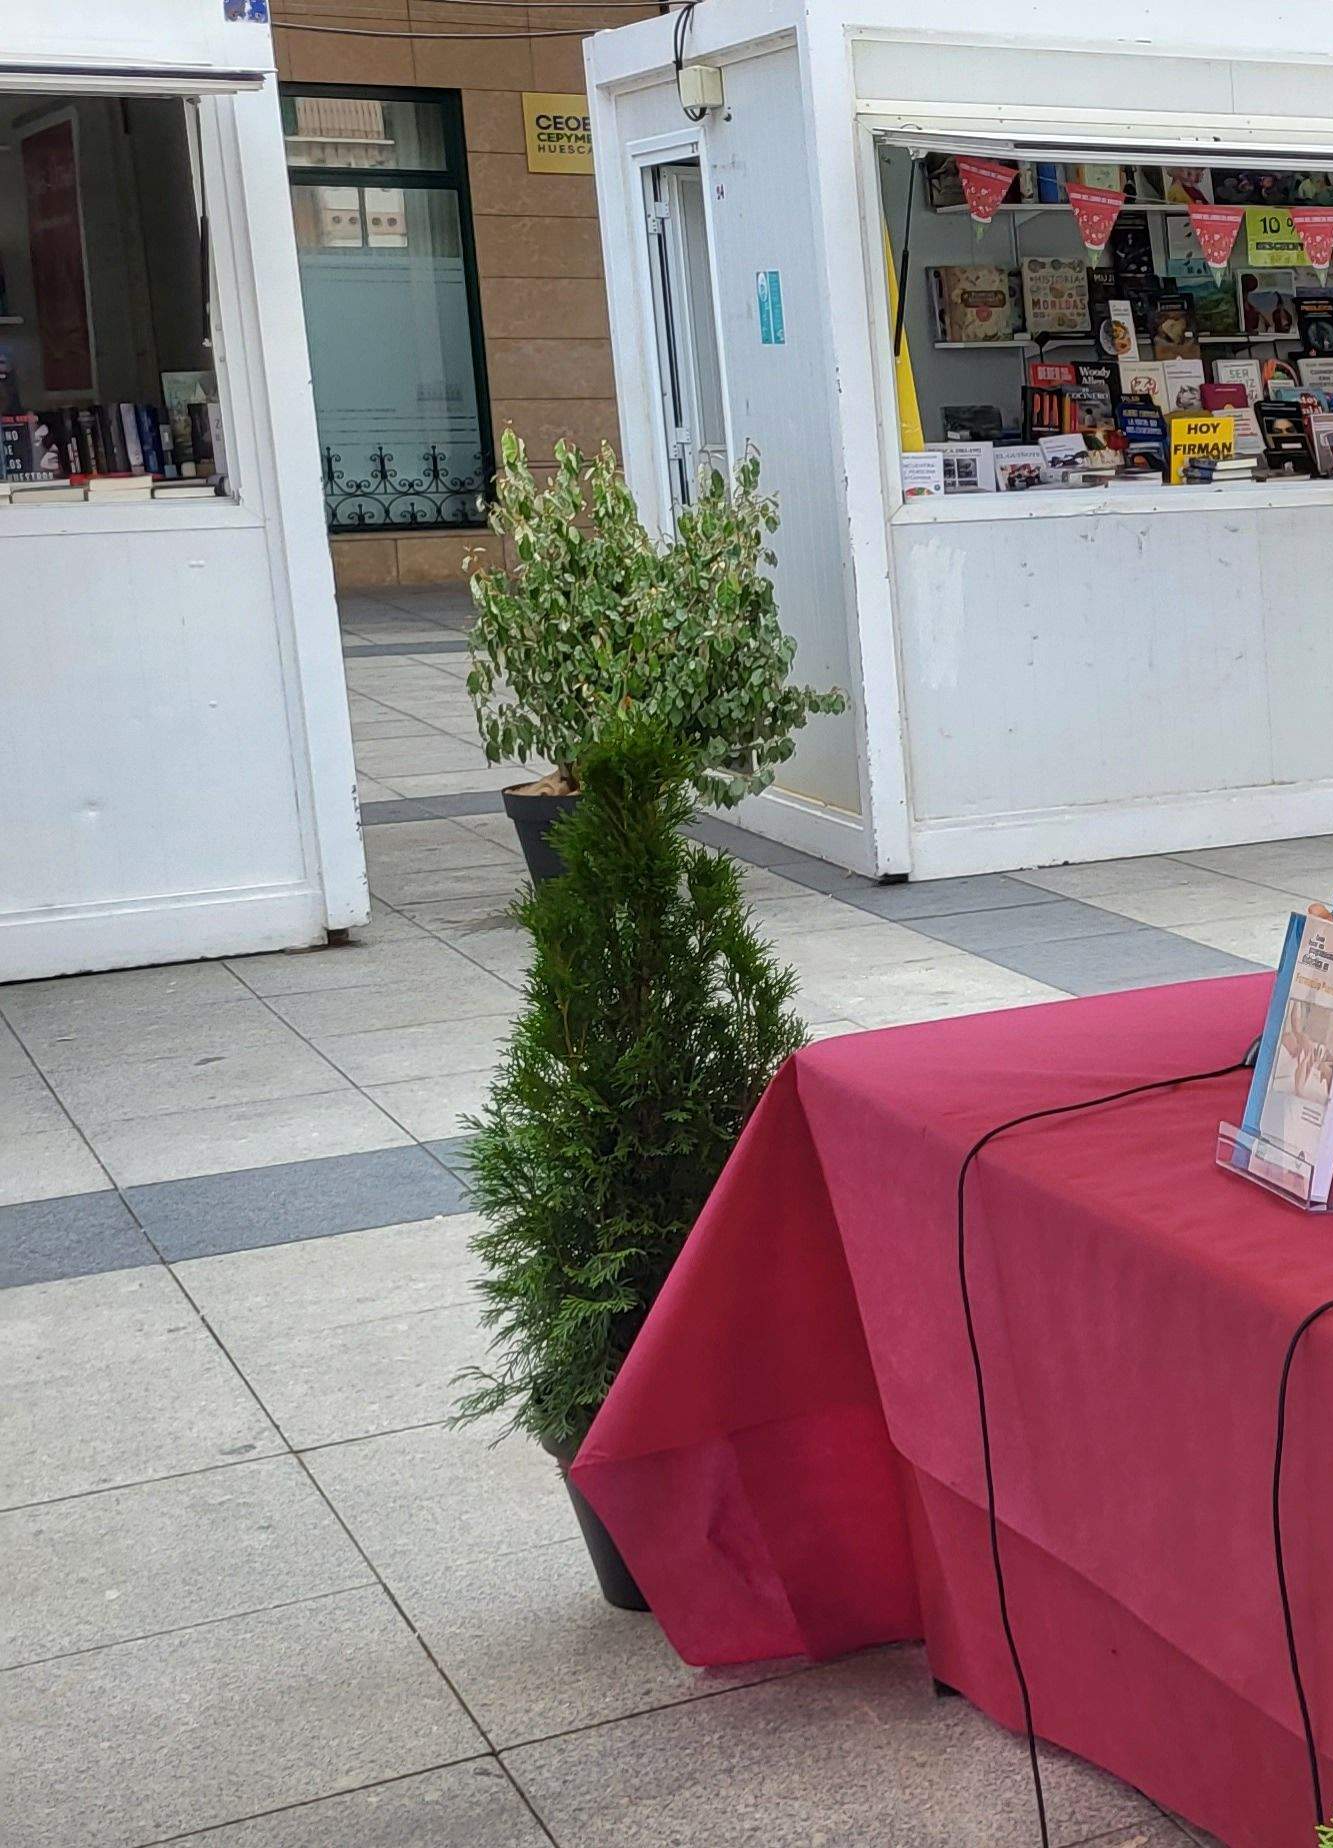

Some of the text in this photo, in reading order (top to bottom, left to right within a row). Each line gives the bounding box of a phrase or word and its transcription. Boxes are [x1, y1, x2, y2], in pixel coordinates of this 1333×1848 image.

[1259, 216, 1281, 234] 10
[1187, 422, 1222, 435] HOY
[1173, 442, 1233, 456] FIRMAN
